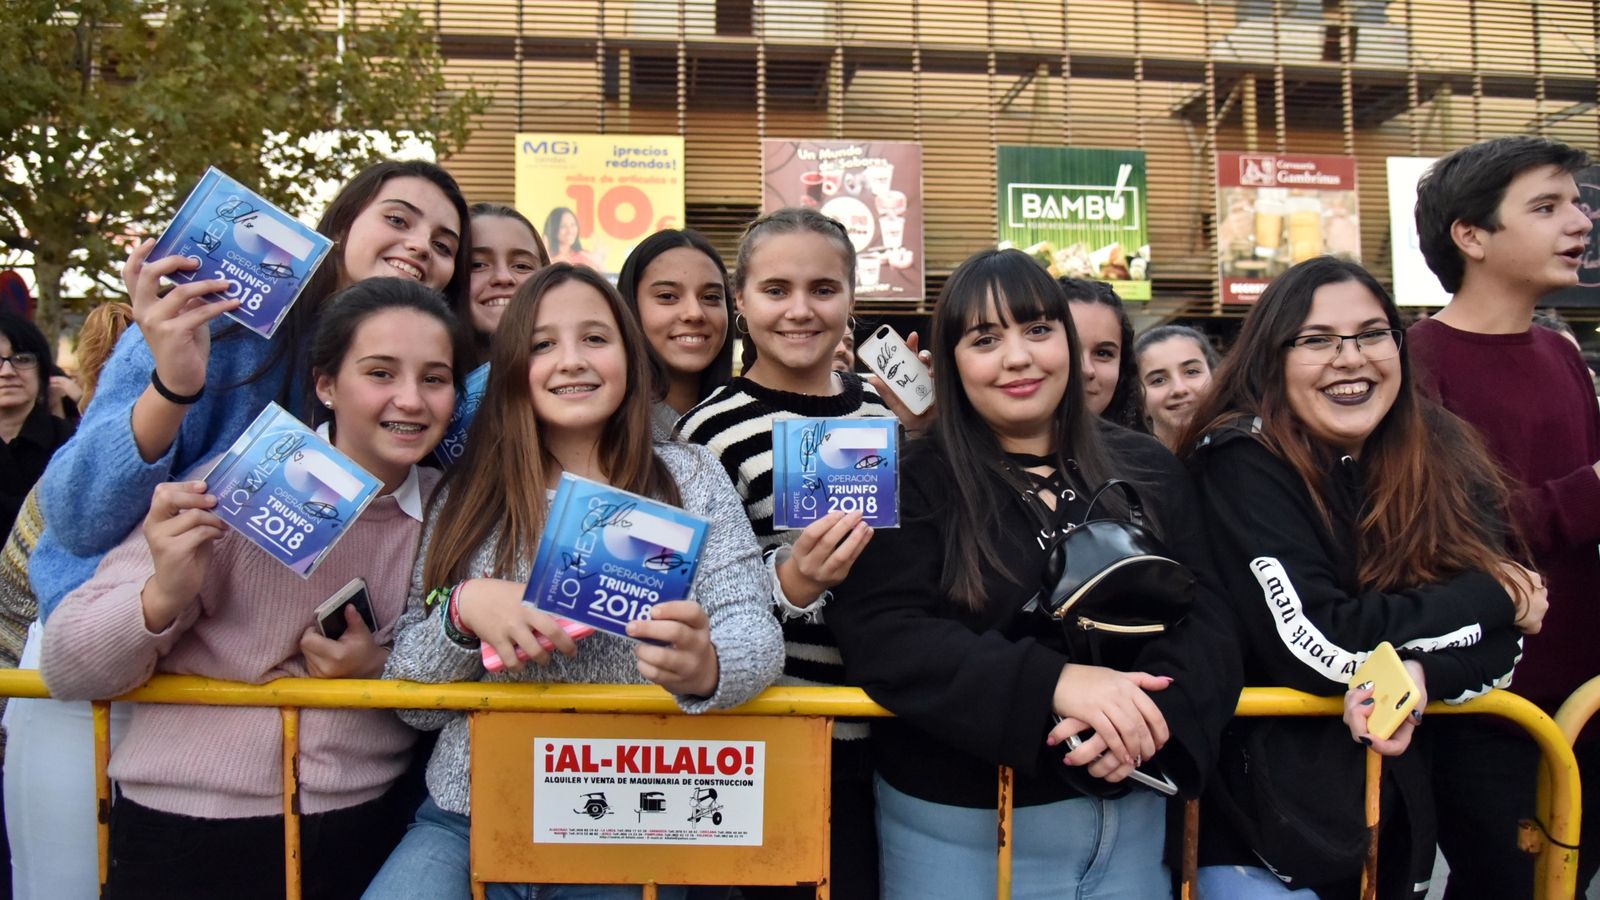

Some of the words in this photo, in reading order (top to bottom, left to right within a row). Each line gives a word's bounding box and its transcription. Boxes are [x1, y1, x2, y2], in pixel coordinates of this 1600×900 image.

[613, 144, 668, 157] ¡precios
[797, 149, 816, 160] Un
[818, 145, 863, 160] Mundo
[606, 159, 677, 171] redondos!
[600, 174, 614, 184] de
[220, 259, 271, 294] TRIUNFO
[214, 271, 263, 311] 2018
[827, 474, 878, 483] OPERACIÓN
[827, 485, 878, 494] TRIUNFO
[222, 489, 249, 516] LO
[266, 495, 314, 534] TRIUNFO
[827, 496, 878, 514] 2018
[250, 506, 305, 550] 2018
[551, 568, 565, 595] PARTE
[598, 575, 659, 603] TRIUNFO
[601, 562, 664, 590] OPERACIÓN
[556, 578, 581, 609] LO
[589, 589, 652, 621] 2018
[544, 742, 756, 776] ¡AL-KILALO!
[544, 776, 582, 785] ALQUILER
[583, 777, 590, 785] Y
[591, 777, 615, 785] VENTA
[617, 777, 627, 785] DE
[629, 777, 680, 786] MAQUINARIA
[682, 778, 692, 786] DE
[694, 778, 754, 787] CONSTRUCCION
